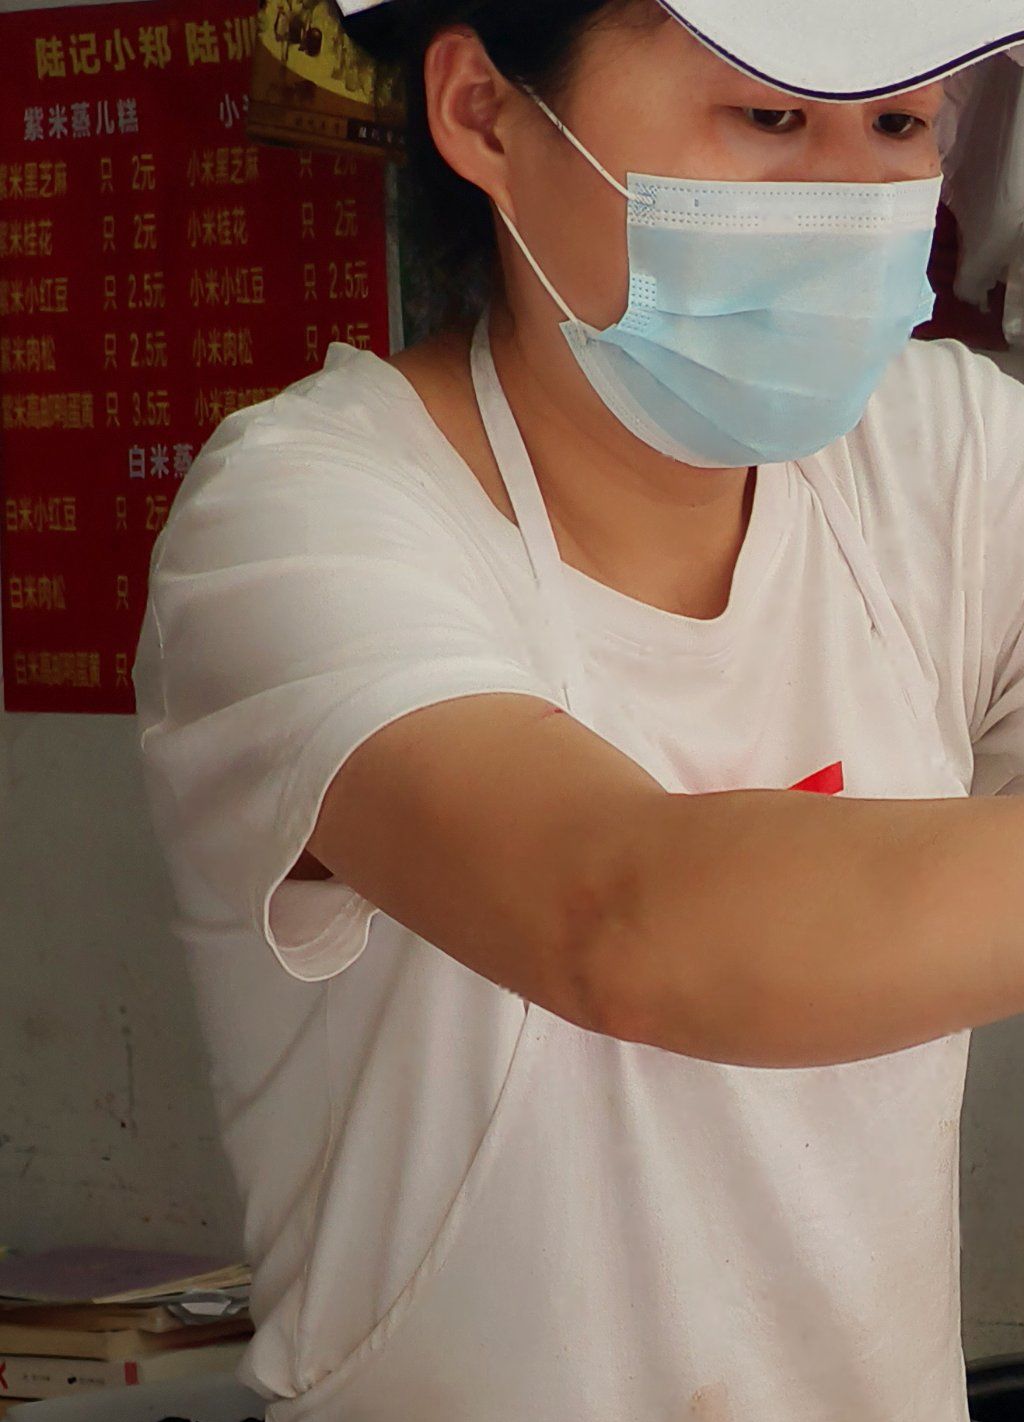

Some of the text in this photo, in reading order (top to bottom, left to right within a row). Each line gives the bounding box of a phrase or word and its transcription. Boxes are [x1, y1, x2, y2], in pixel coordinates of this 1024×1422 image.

[35, 24, 172, 80] 陆记小郑
[24, 97, 139, 142] 紫米蒸儿糕
[98, 157, 114, 194] 只
[131, 154, 157, 191] 2元
[100, 214, 116, 252] 只
[133, 212, 159, 250] 2元
[301, 202, 316, 239] 只
[335, 199, 358, 237] 2元
[103, 274, 118, 310] 只
[128, 271, 166, 308] 2.5元
[190, 260, 370, 305] 小米小红豆 只 2.5元
[104, 332, 118, 369] 只
[130, 329, 169, 367] 2.5元
[305, 325, 319, 363] 只
[331, 323, 372, 351] 25元
[106, 391, 121, 428] 只
[132, 388, 172, 428] 3.5元
[129, 442, 204, 480] 白米蒸
[5, 495, 77, 533] 白米小红豆
[116, 495, 128, 531] 只
[116, 574, 129, 611] 只
[115, 651, 129, 687] 只
